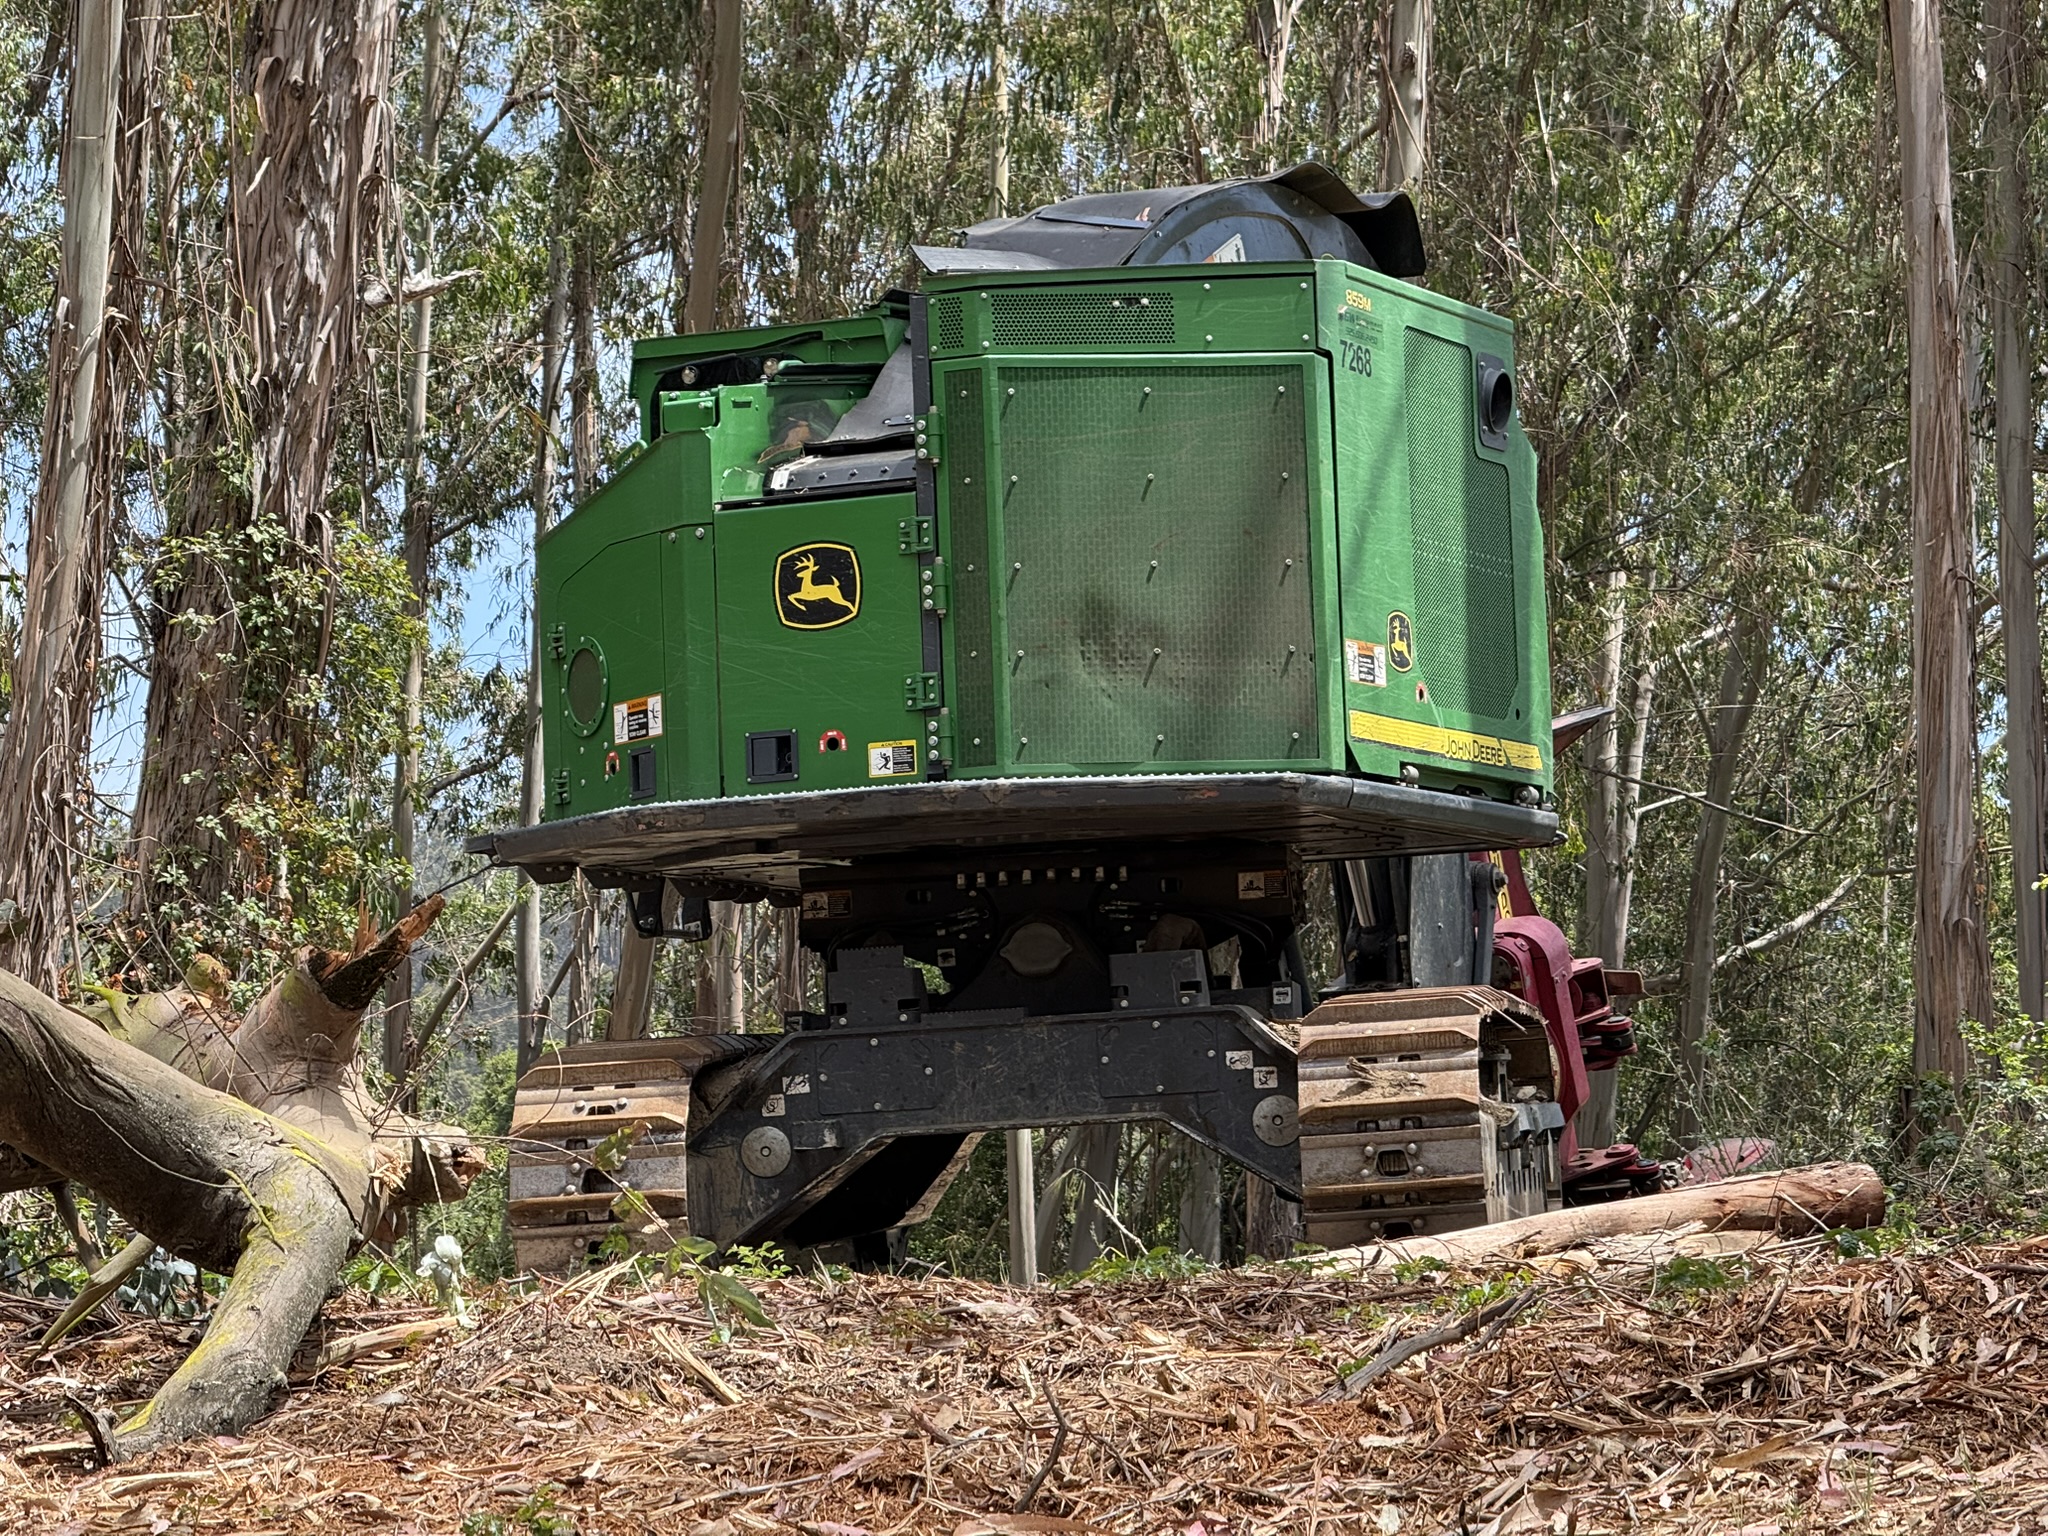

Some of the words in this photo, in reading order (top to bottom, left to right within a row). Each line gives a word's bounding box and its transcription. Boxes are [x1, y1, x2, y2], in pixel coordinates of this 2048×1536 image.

[1345, 289, 1371, 312] 859M
[1340, 339, 1372, 378] 7268
[1445, 735, 1472, 758] JOHN
[1472, 739, 1503, 764] DEERE
